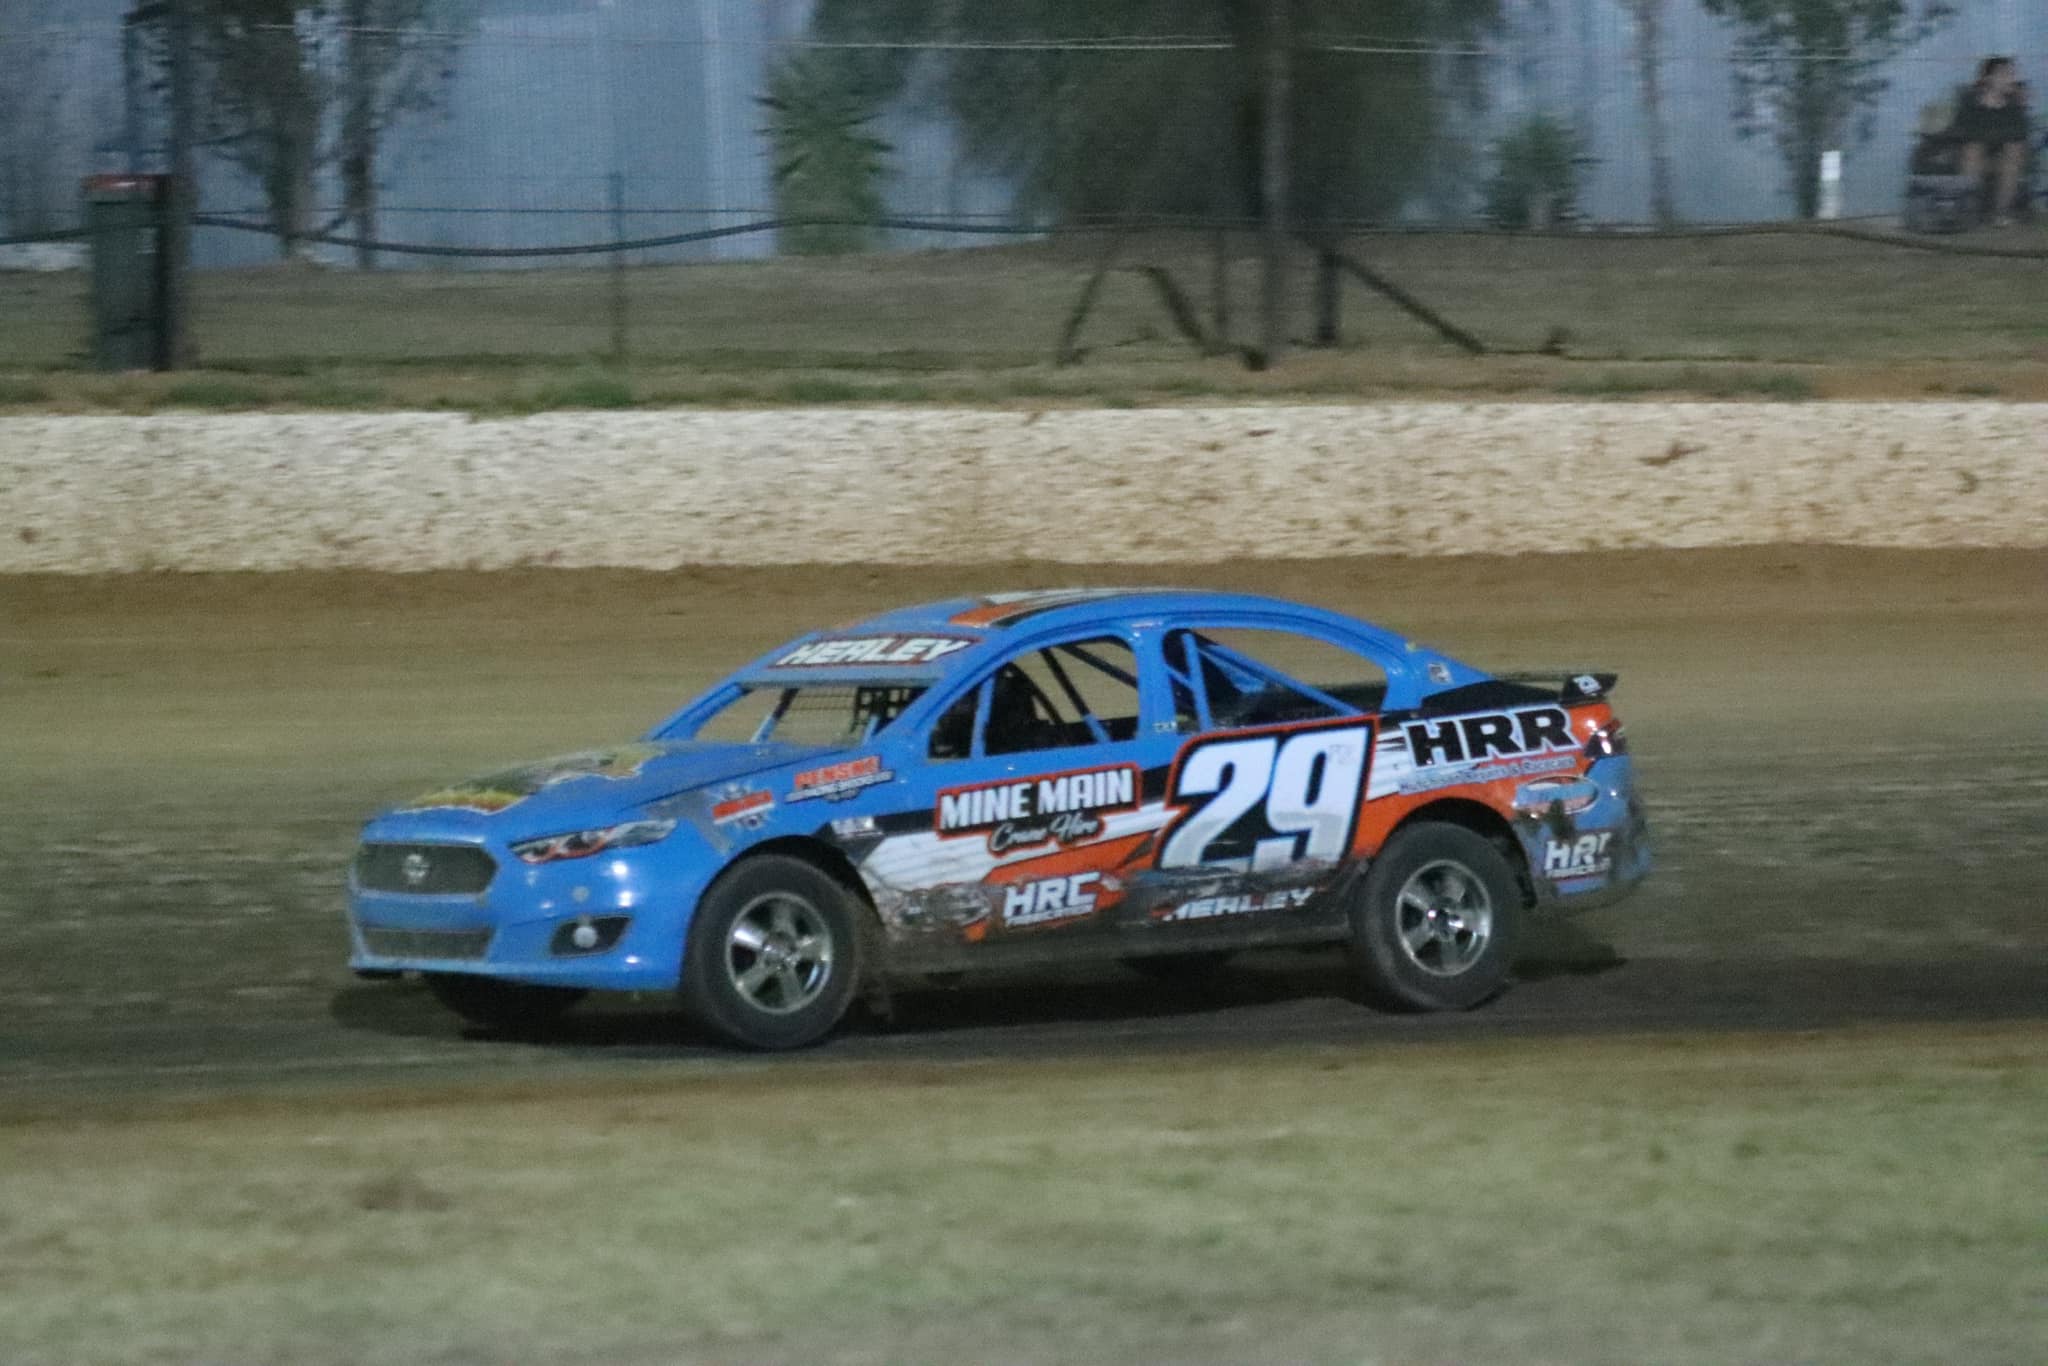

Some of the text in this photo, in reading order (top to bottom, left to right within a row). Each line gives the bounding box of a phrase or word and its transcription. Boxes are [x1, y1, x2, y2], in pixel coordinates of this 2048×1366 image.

[776, 637, 973, 666] HEALEY
[1404, 706, 1578, 768] HRR
[940, 782, 1031, 830] MINE
[1037, 768, 1133, 815] MAIN
[1161, 726, 1369, 873] 29
[1003, 872, 1100, 918] HRC
